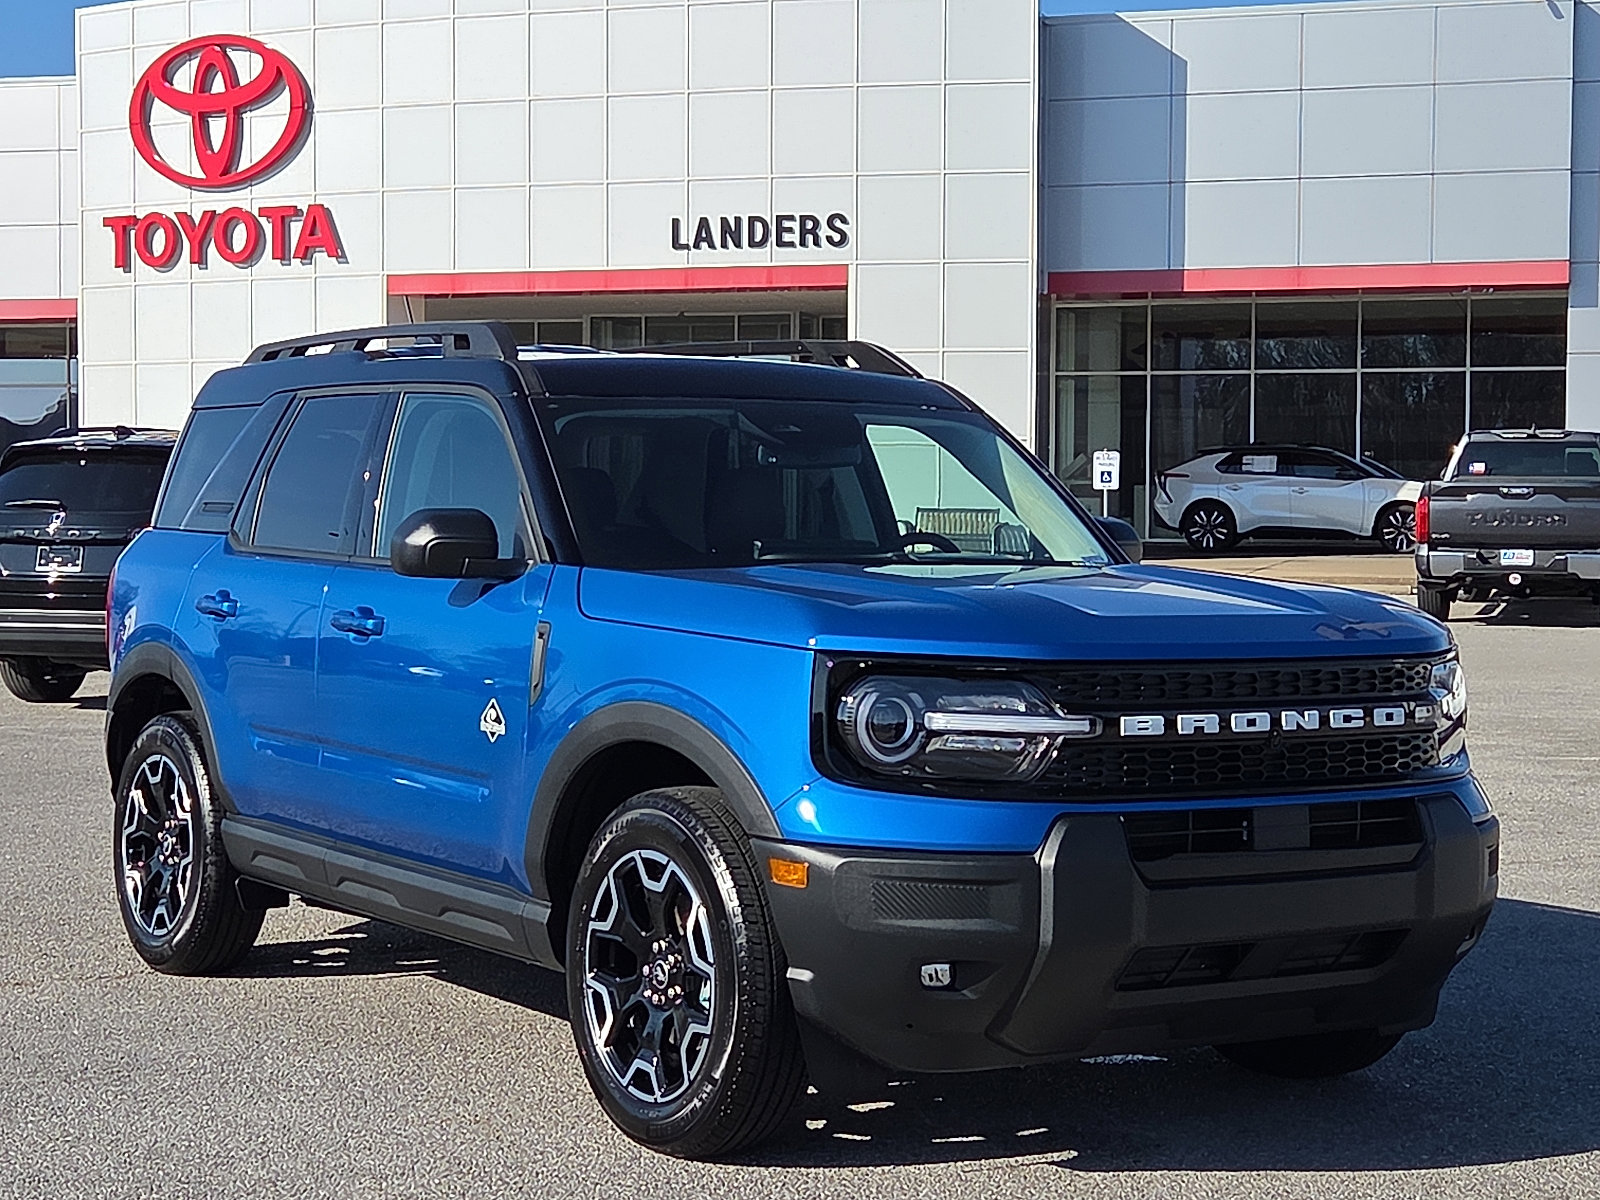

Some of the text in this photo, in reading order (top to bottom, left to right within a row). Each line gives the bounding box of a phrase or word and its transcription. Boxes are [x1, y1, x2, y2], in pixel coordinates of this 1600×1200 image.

[103, 204, 345, 271] TOYOTA
[671, 213, 850, 250] LANDERS
[1465, 509, 1568, 527] TUNDRA
[1119, 708, 1405, 736] BRONCO
